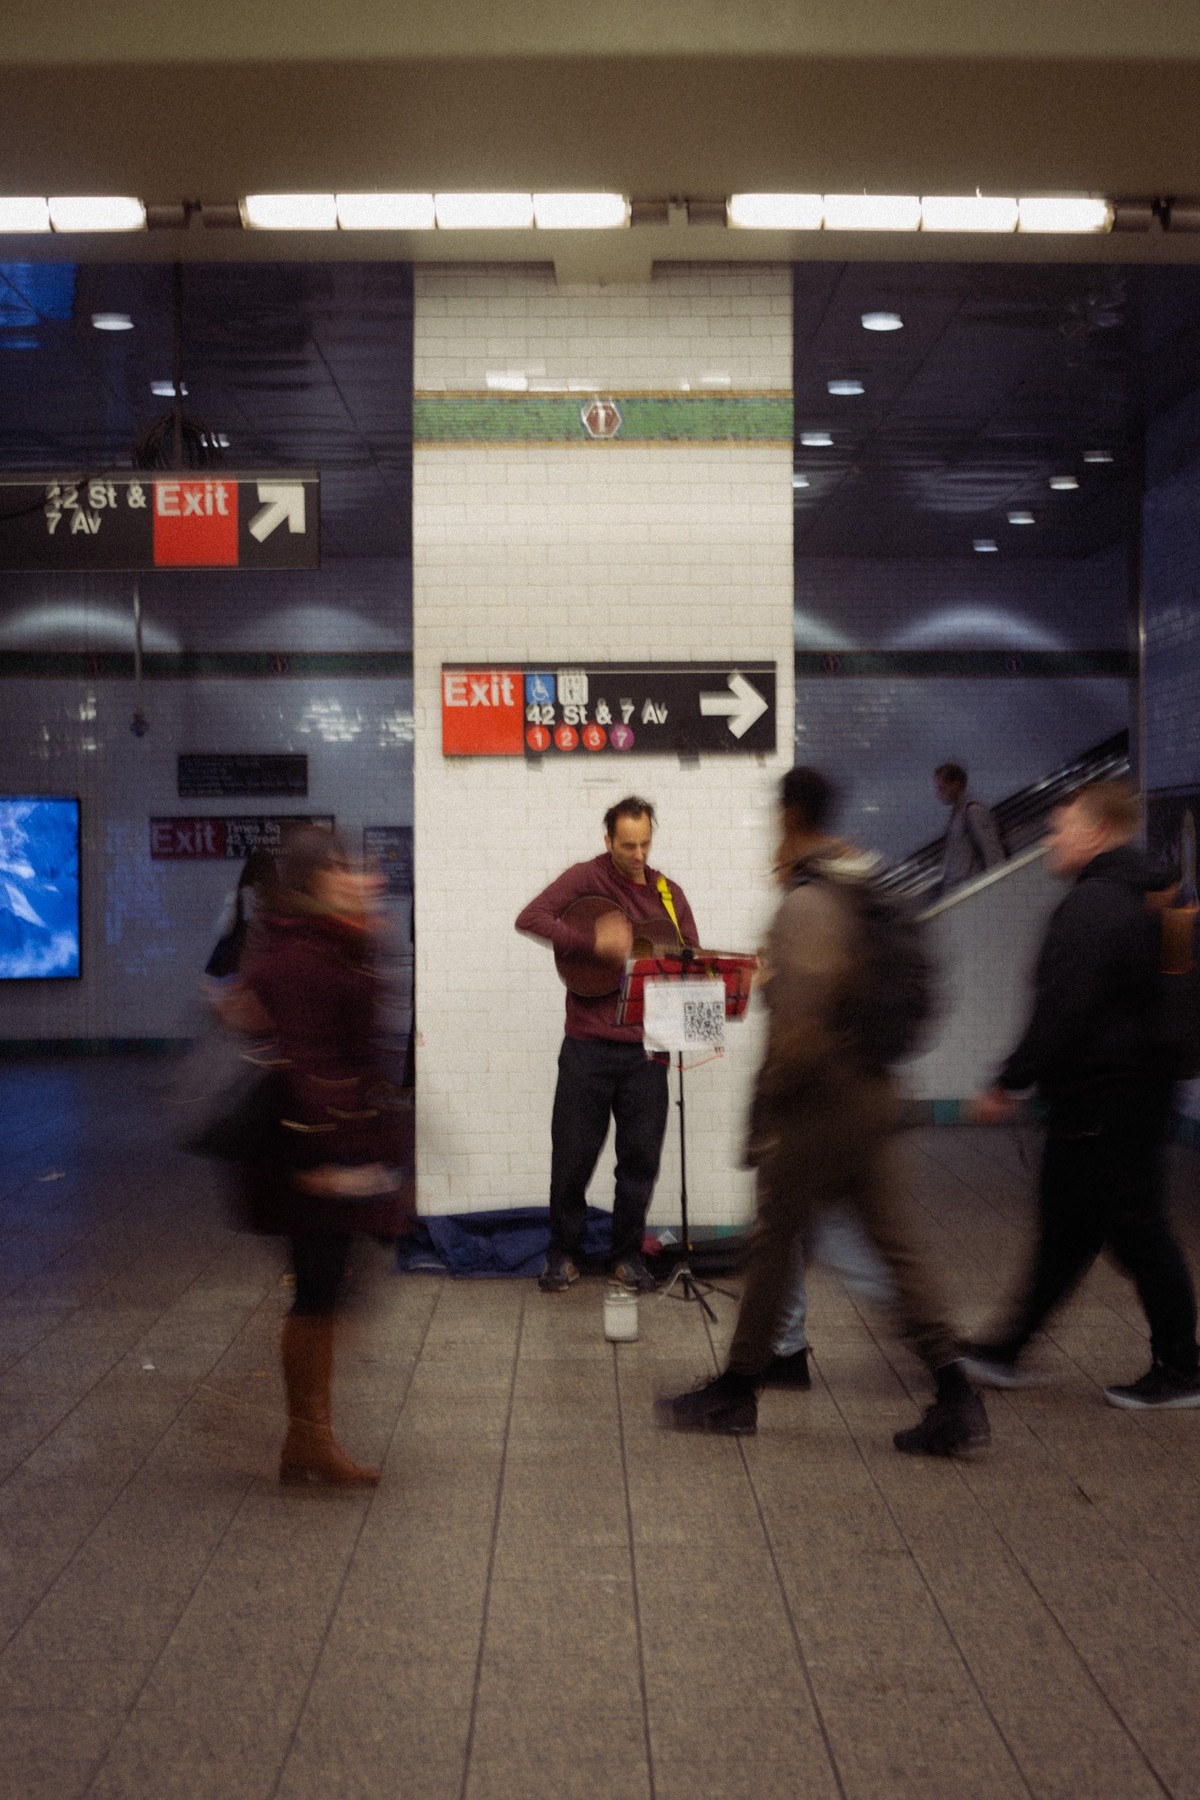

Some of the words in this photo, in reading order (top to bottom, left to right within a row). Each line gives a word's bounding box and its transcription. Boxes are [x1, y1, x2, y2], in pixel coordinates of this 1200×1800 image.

[89, 481, 118, 509] St
[127, 482, 147, 509] &
[156, 481, 229, 517] Exit
[46, 512, 62, 535] 7
[444, 675, 515, 707] Exit
[527, 702, 555, 725] 42
[564, 704, 588, 725] St
[596, 702, 612, 725] &
[620, 702, 635, 725] 7
[534, 730, 543, 748] 1
[561, 729, 573, 747] 2
[588, 729, 601, 746] 3
[616, 730, 628, 748] 7
[151, 822, 218, 853] Exit
